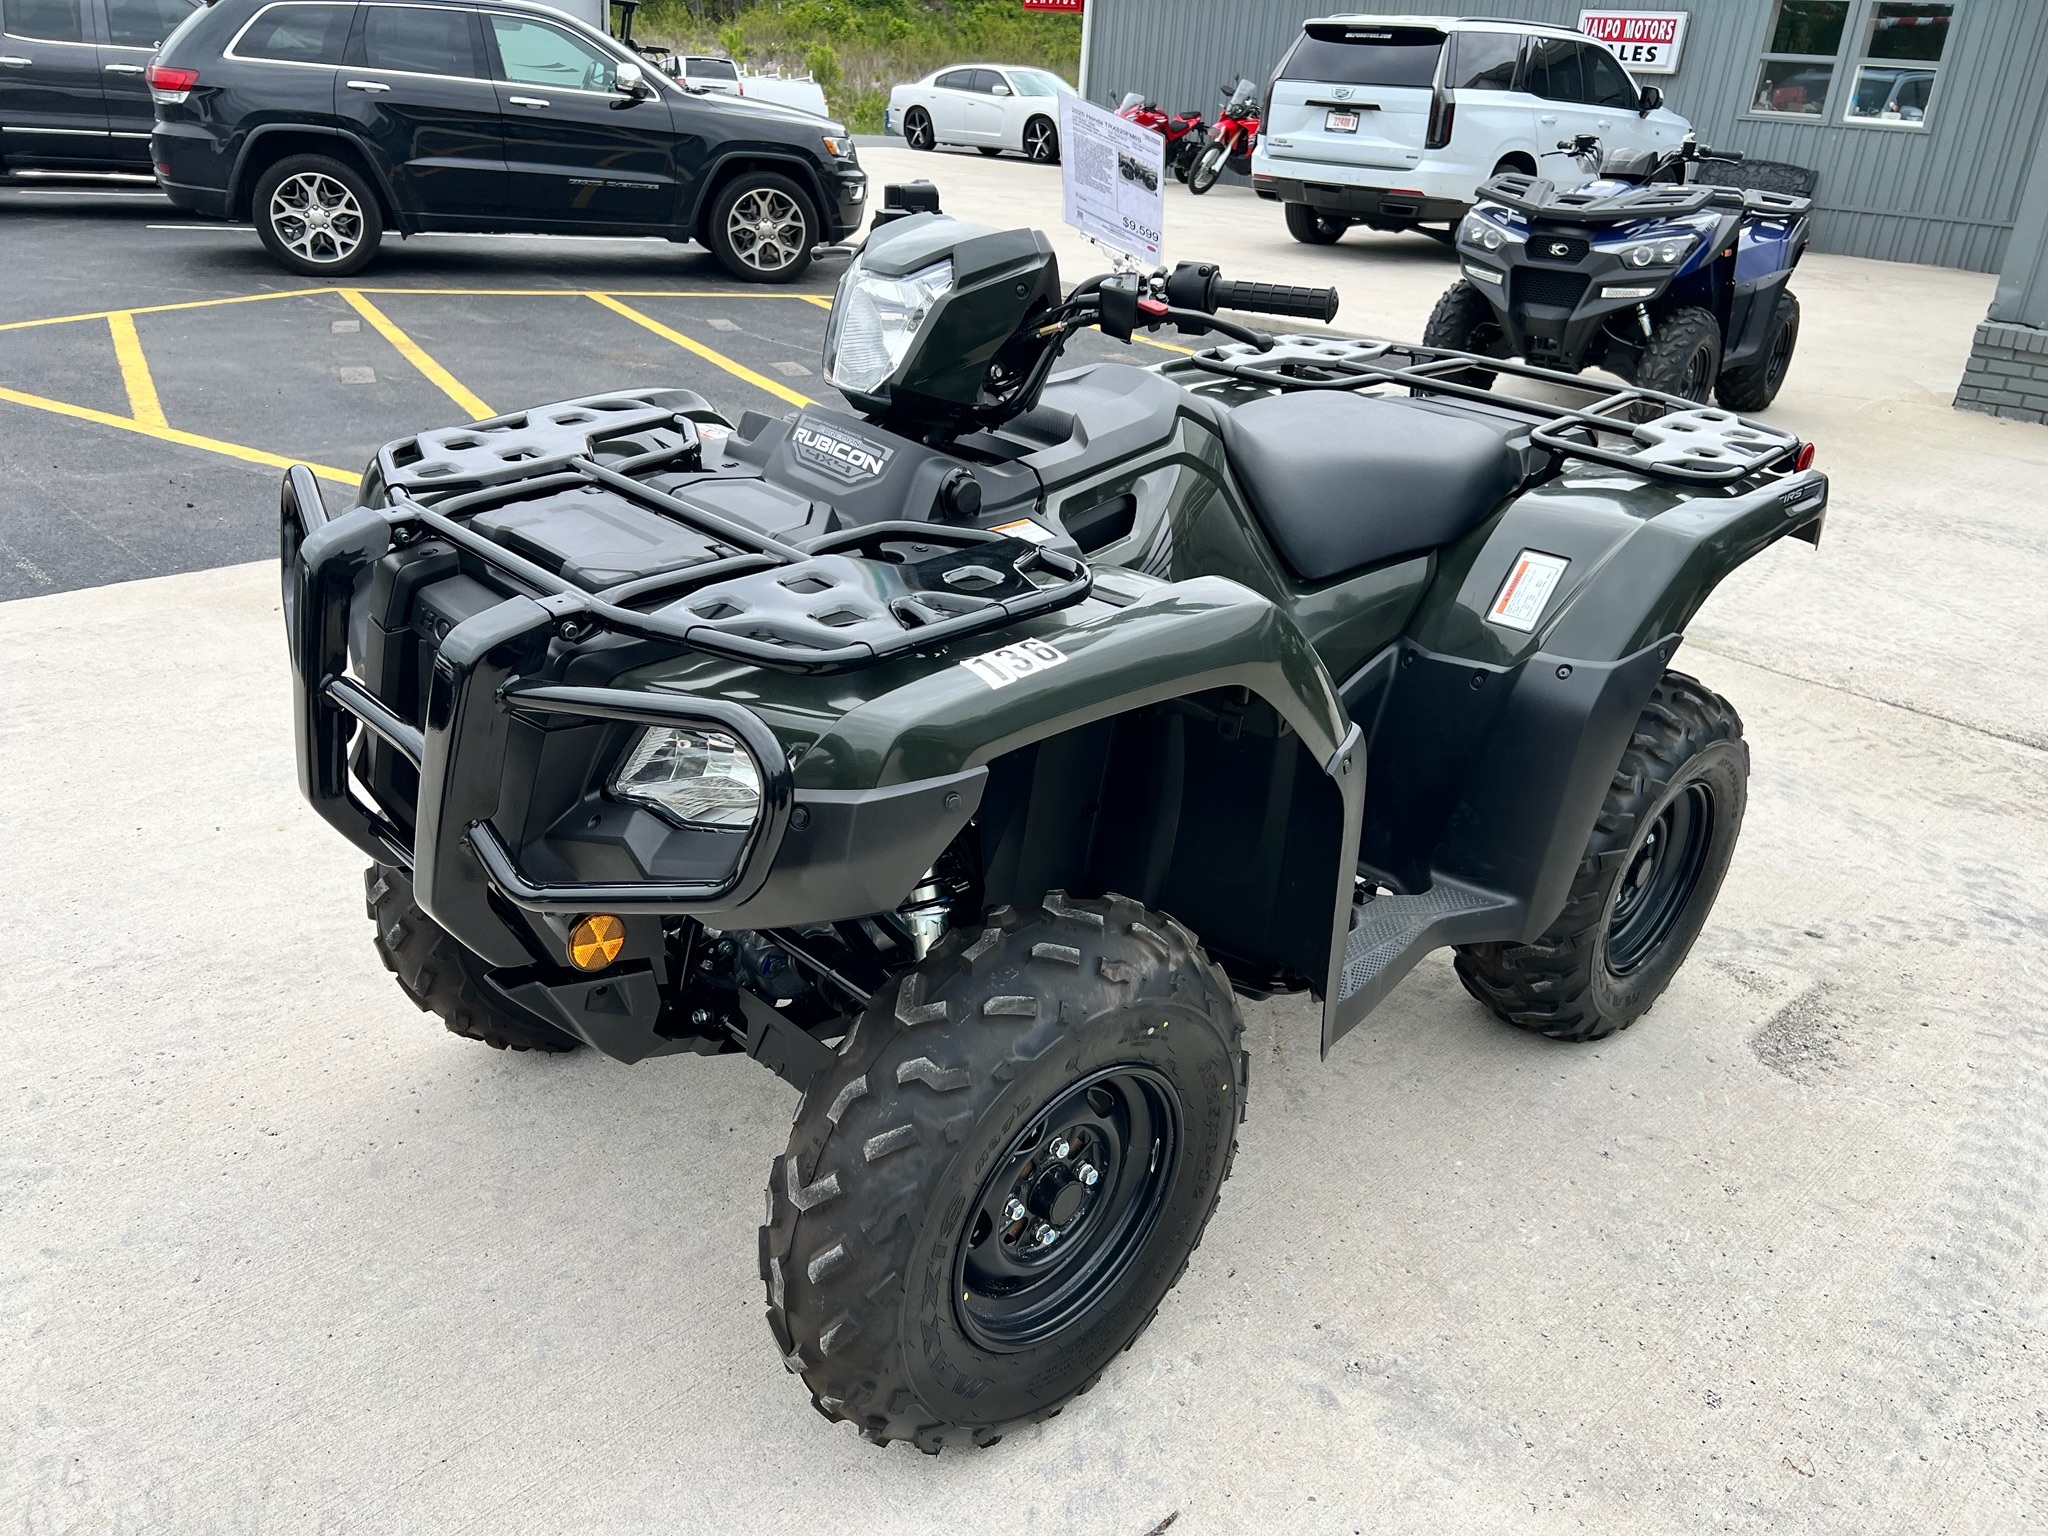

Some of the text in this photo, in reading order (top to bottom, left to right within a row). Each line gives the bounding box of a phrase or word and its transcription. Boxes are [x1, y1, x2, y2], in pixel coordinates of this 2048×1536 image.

[1584, 18, 1675, 41] VALPO MOTORS
[1085, 112, 1104, 126] Honda
[1122, 216, 1159, 242] $9,599
[792, 427, 884, 475] RUBICON
[1783, 487, 1804, 503] IRS
[971, 641, 1059, 682] 136
[921, 1191, 989, 1401] MAXXIS
